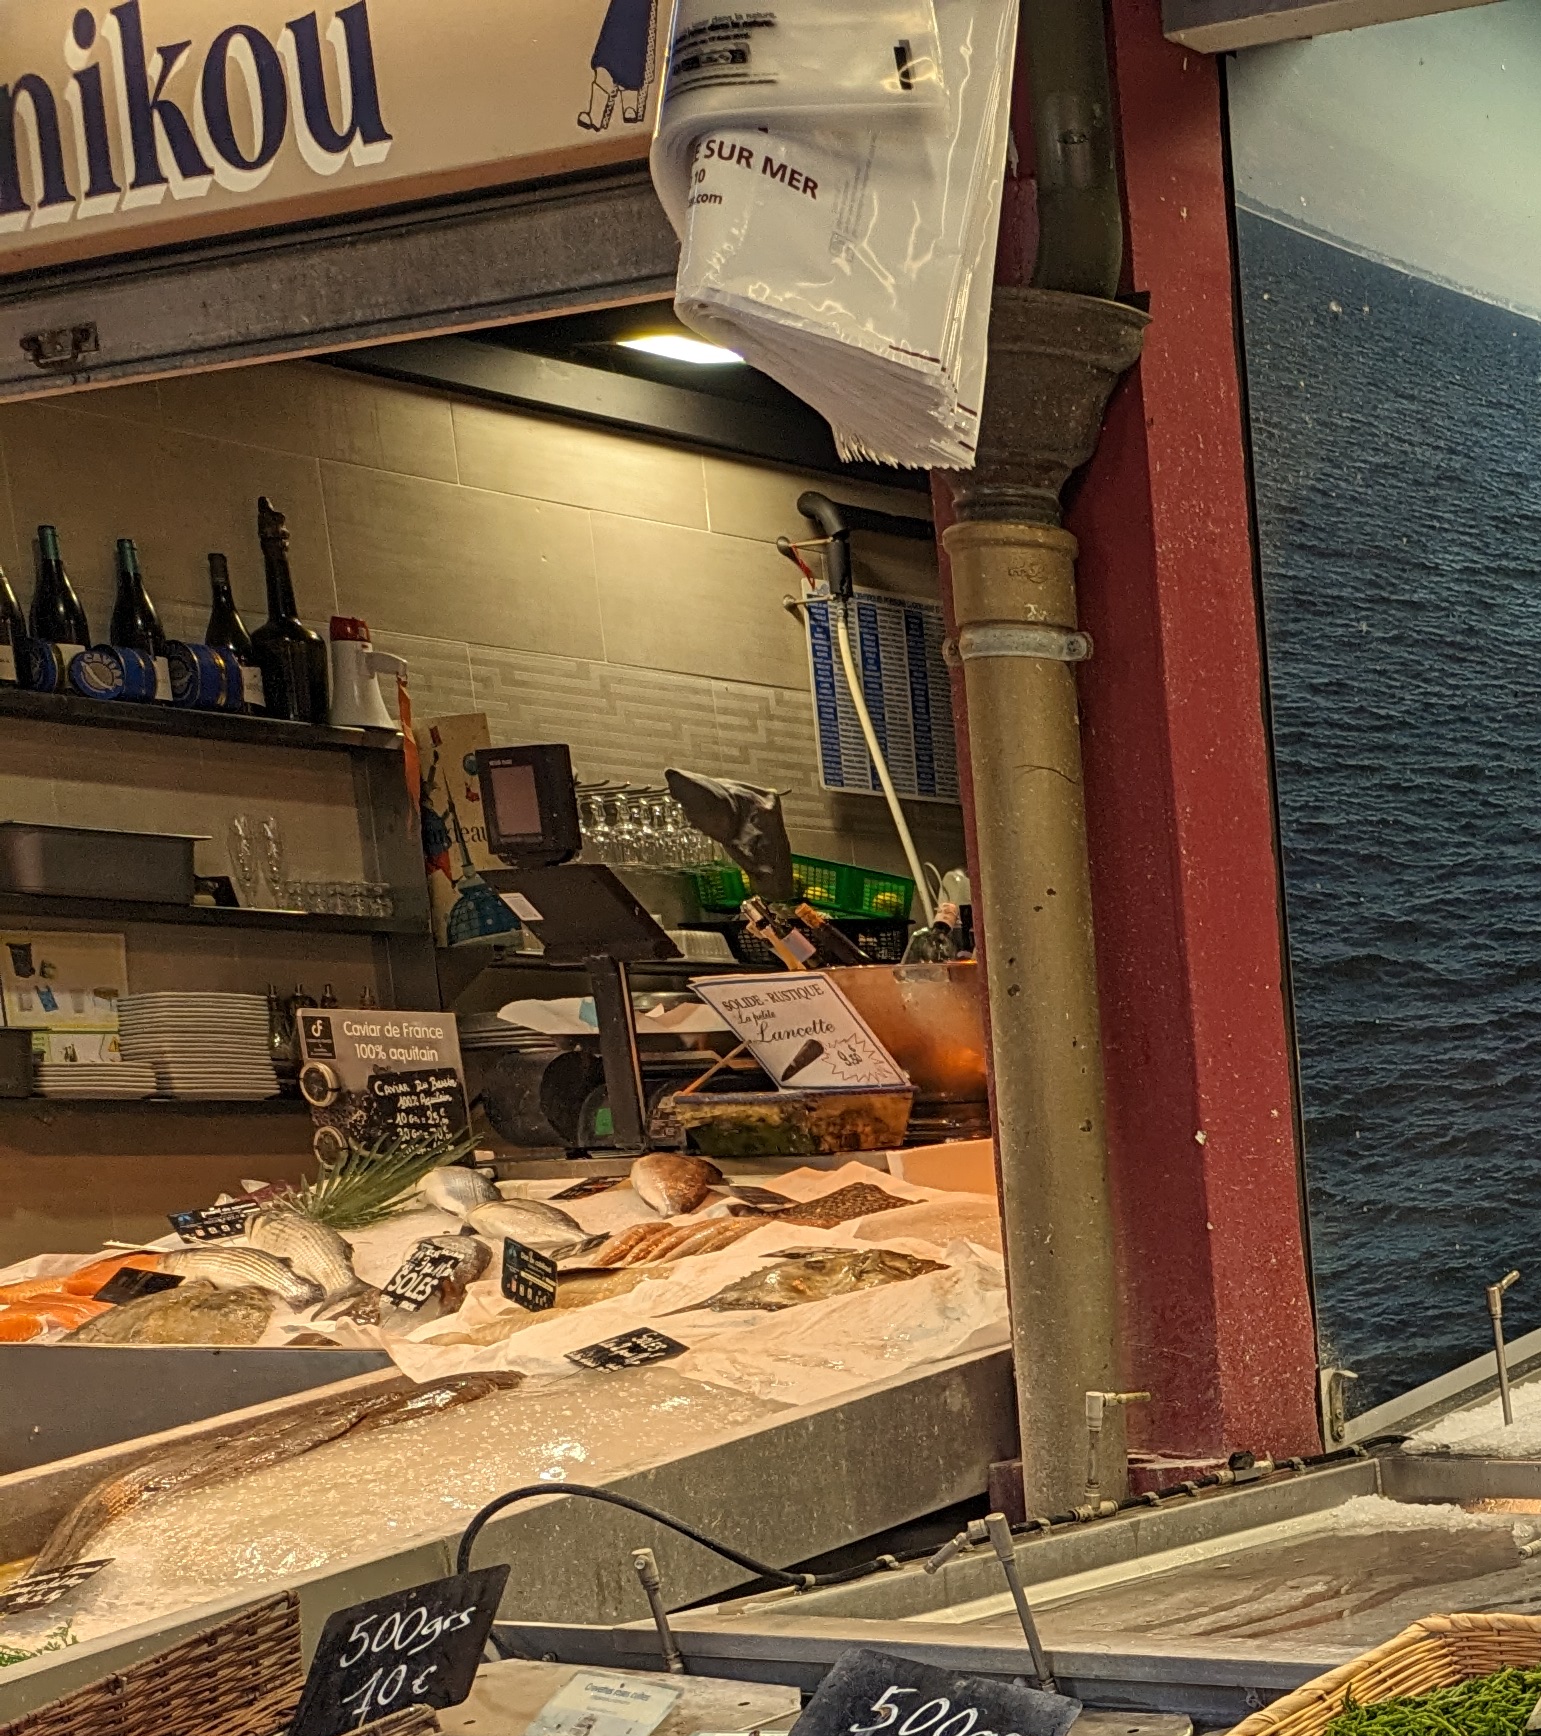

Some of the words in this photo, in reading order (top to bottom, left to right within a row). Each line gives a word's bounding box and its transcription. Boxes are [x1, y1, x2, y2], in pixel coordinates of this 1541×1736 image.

[704, 139, 754, 170] SUR
[761, 155, 819, 200] MER
[722, 994, 764, 1012] SOLIDE
[767, 983, 825, 1004] RUSTIQUE
[343, 1021, 381, 1037] Caviar
[384, 1021, 401, 1038] de
[403, 1022, 444, 1039] France
[754, 1018, 837, 1044] Lancette
[354, 1042, 387, 1061] 100%
[389, 1045, 439, 1065] aquitain
[387, 1271, 440, 1302] SOLES
[339, 1605, 477, 1668] 500grs
